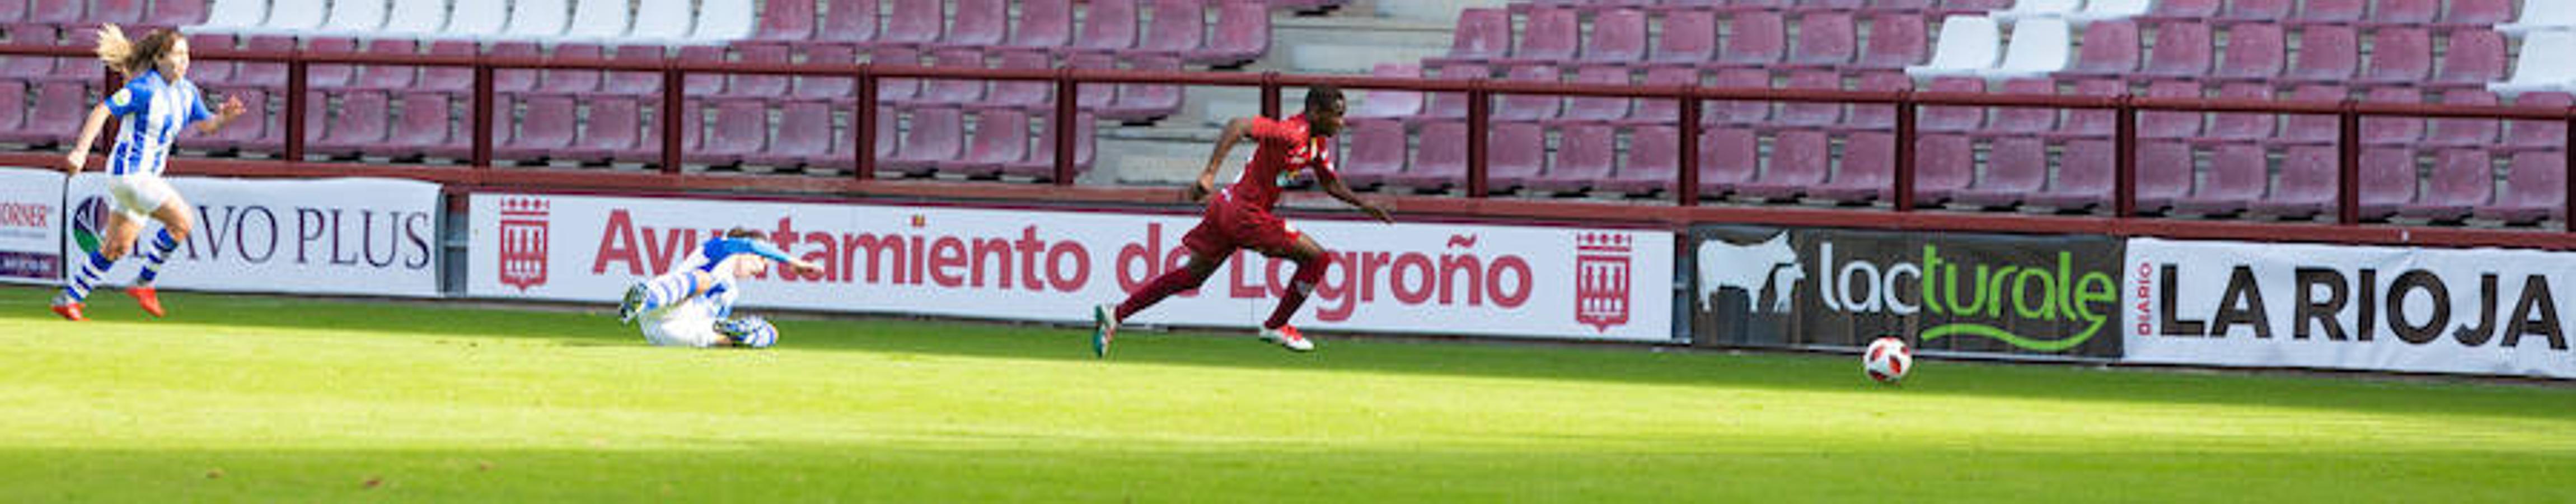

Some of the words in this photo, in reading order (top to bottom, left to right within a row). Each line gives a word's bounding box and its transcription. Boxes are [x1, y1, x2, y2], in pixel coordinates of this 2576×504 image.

[0, 203, 47, 227] ORNER
[130, 206, 278, 263] VO
[294, 206, 430, 270] PLUS
[592, 209, 1092, 292] Aytamiento
[1819, 242, 2118, 322] lacturale
[2137, 262, 2152, 335] DIARIO
[2160, 263, 2273, 339] LA
[2292, 266, 2569, 351] RIOJA
